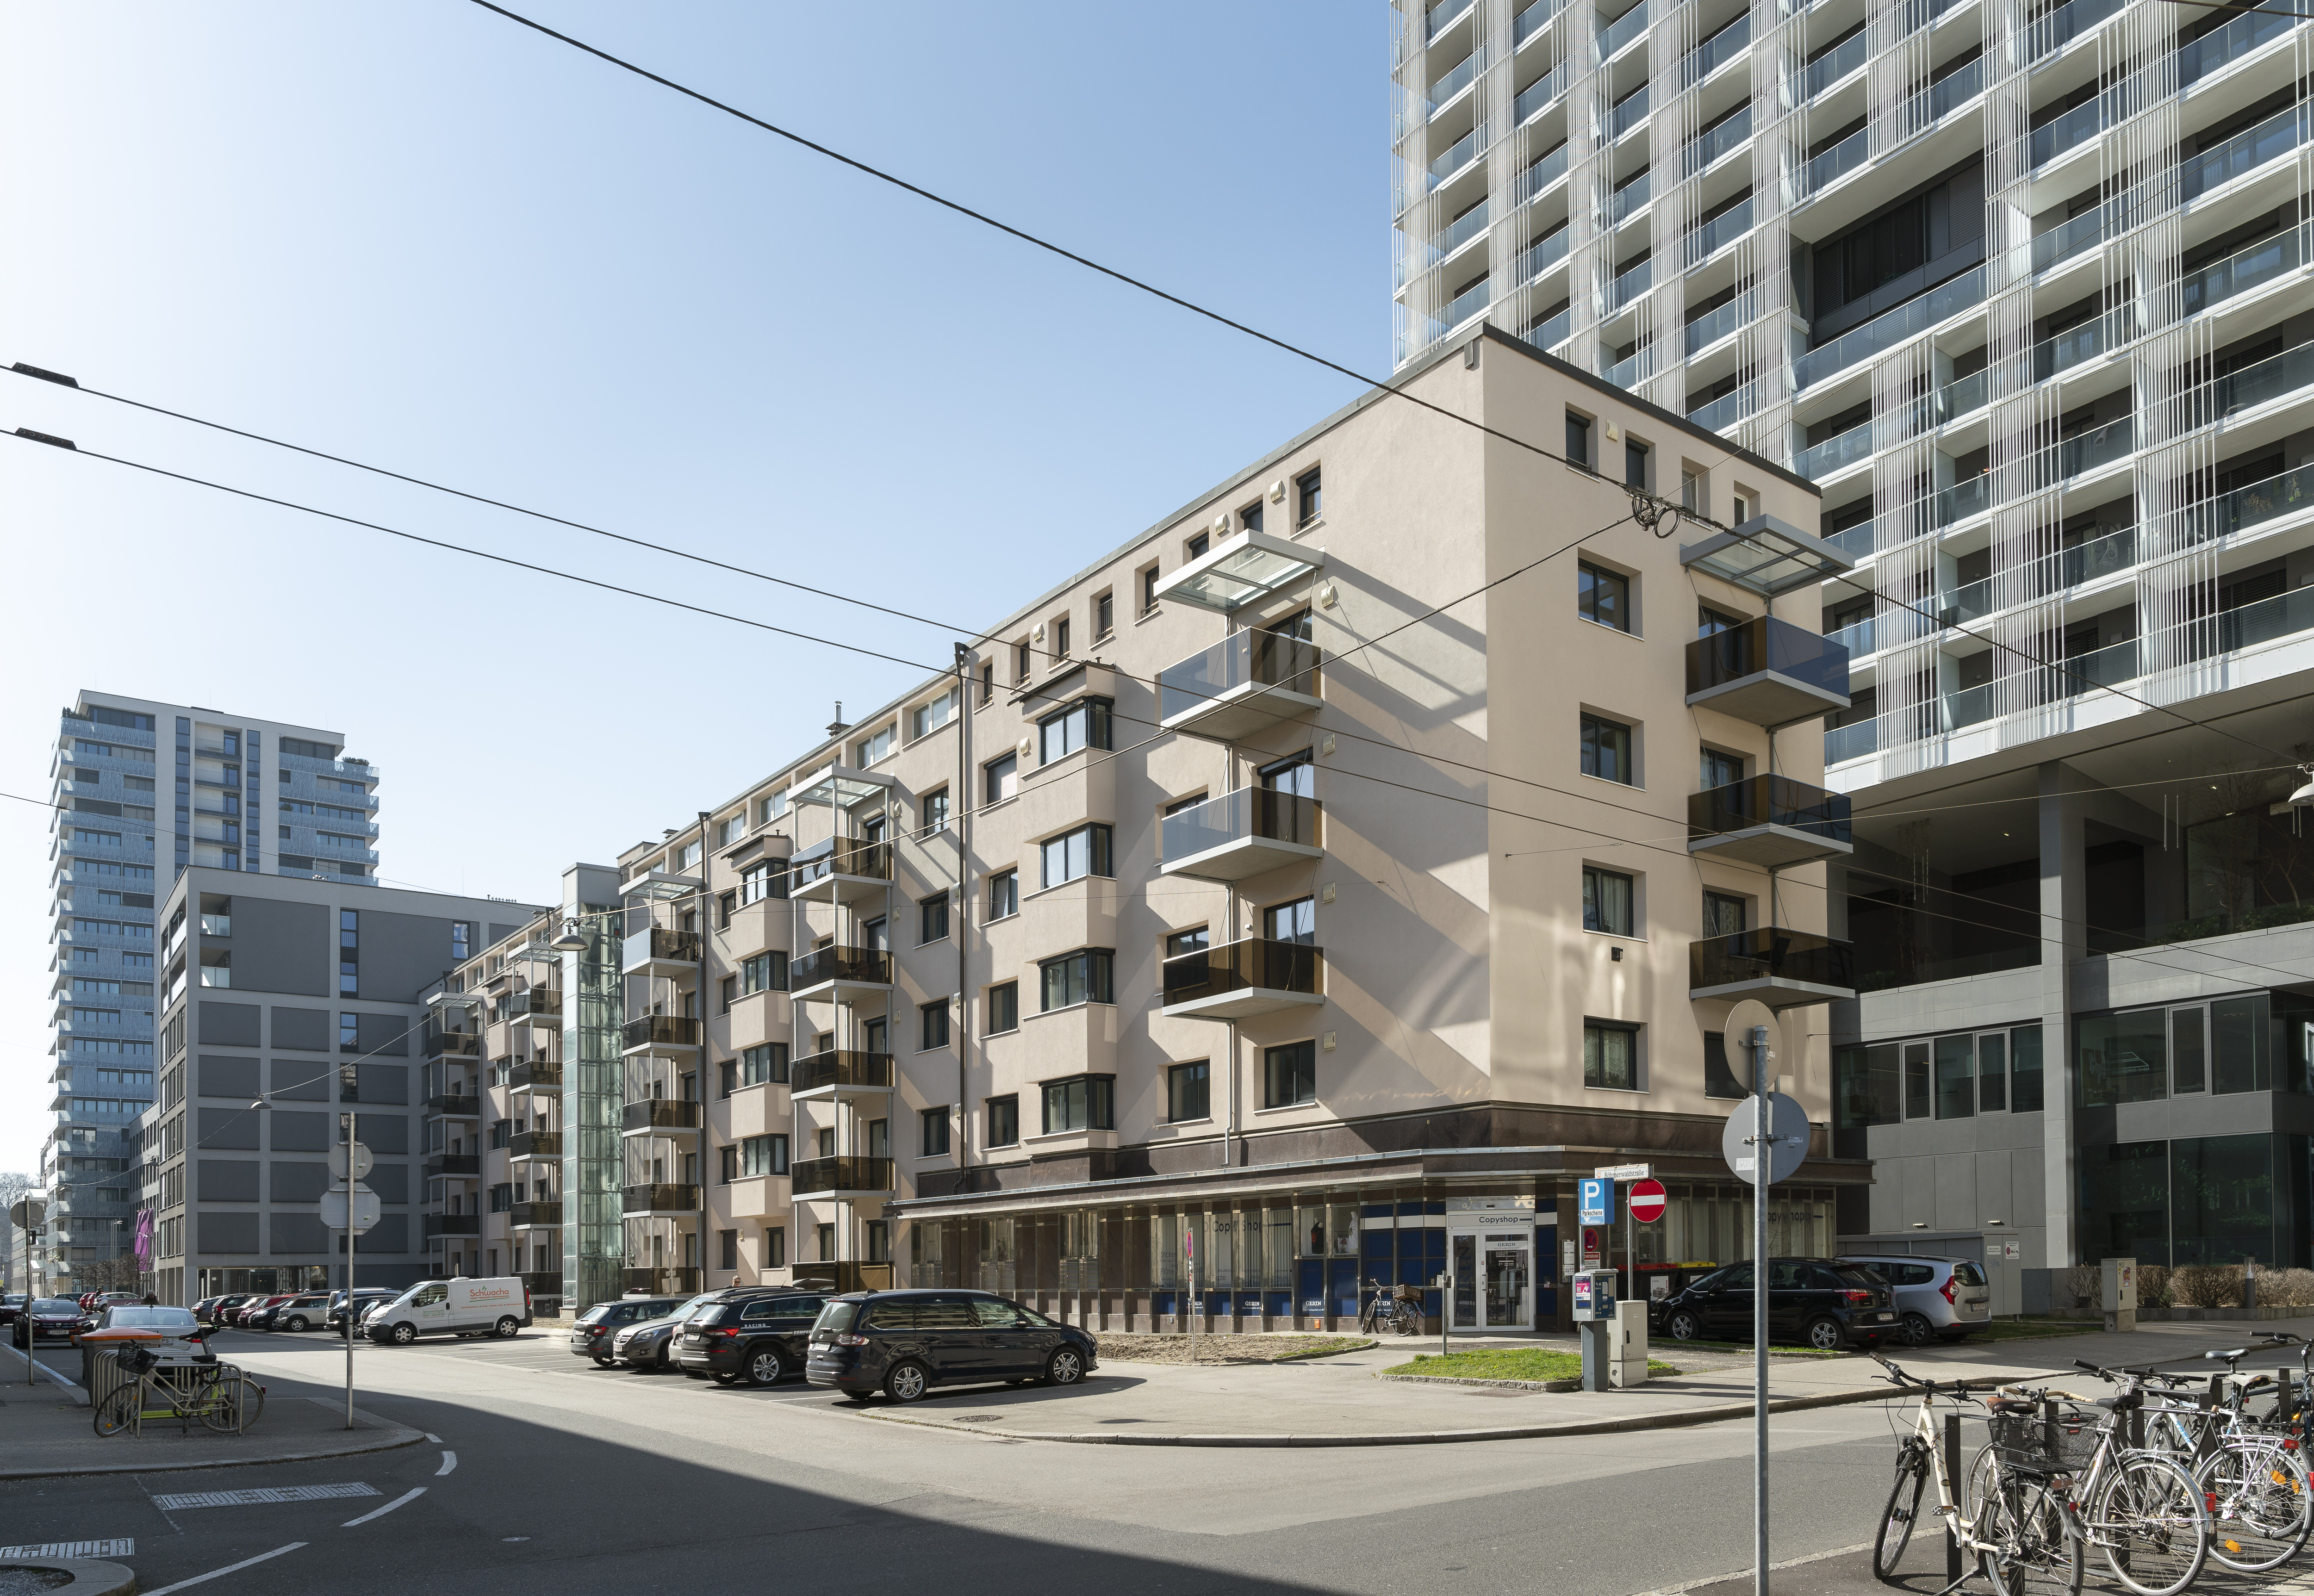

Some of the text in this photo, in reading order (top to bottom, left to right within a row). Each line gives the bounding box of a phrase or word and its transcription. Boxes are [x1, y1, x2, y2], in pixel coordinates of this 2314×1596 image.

[1605, 1169, 1644, 1178] Böhmerwaldstraße
[1585, 1182, 1599, 1209] P
[470, 1287, 509, 1297] Schwacha
[2176, 1420, 2191, 1444] TREK
